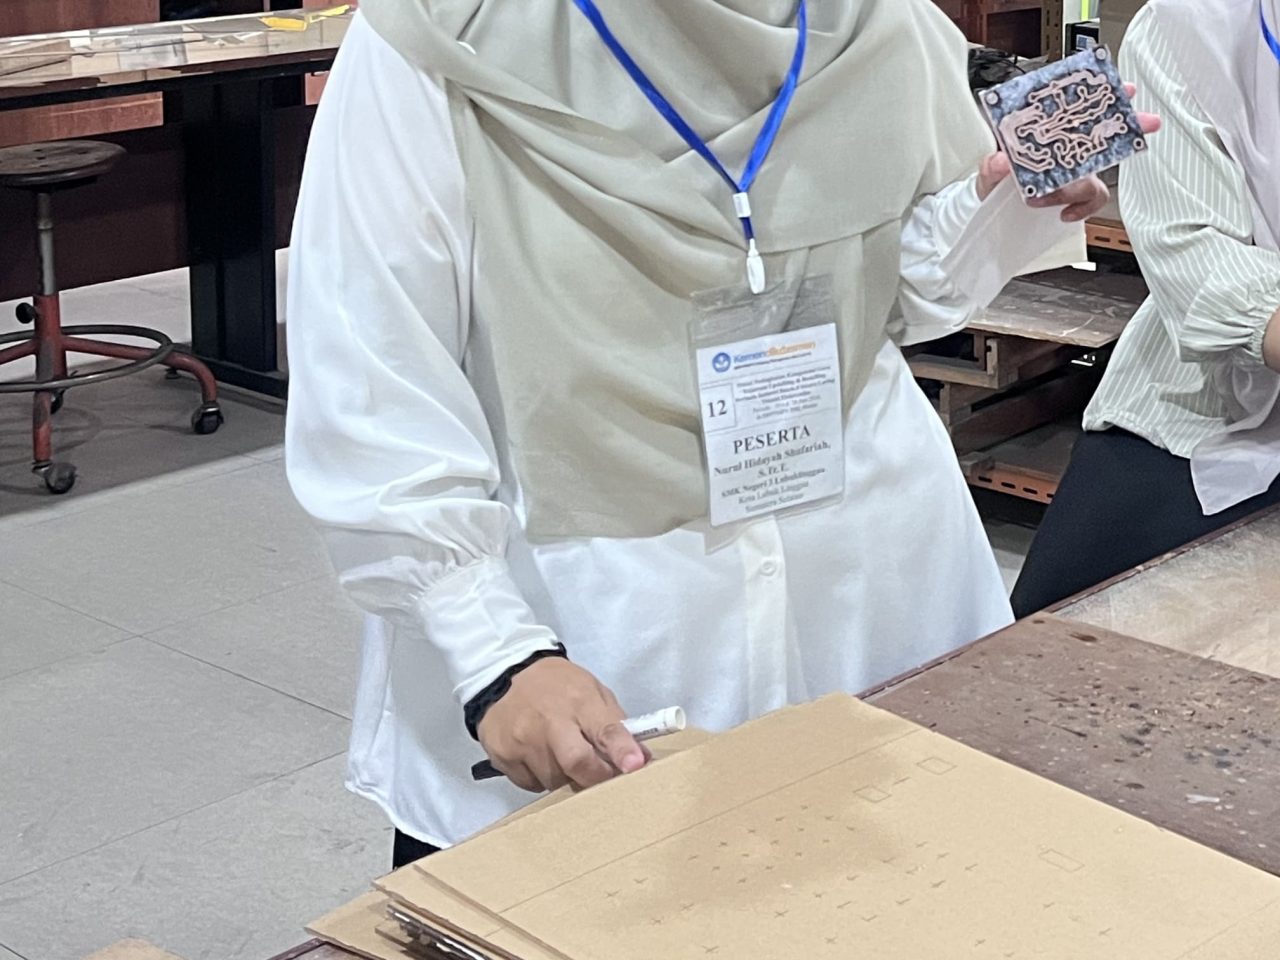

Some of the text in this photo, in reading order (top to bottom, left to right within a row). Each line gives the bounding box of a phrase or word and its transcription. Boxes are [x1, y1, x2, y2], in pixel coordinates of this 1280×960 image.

[708, 399, 728, 418] 12
[733, 424, 811, 455] PESERTA
[714, 461, 742, 476] Nurul
[744, 452, 782, 470] Hidayah
